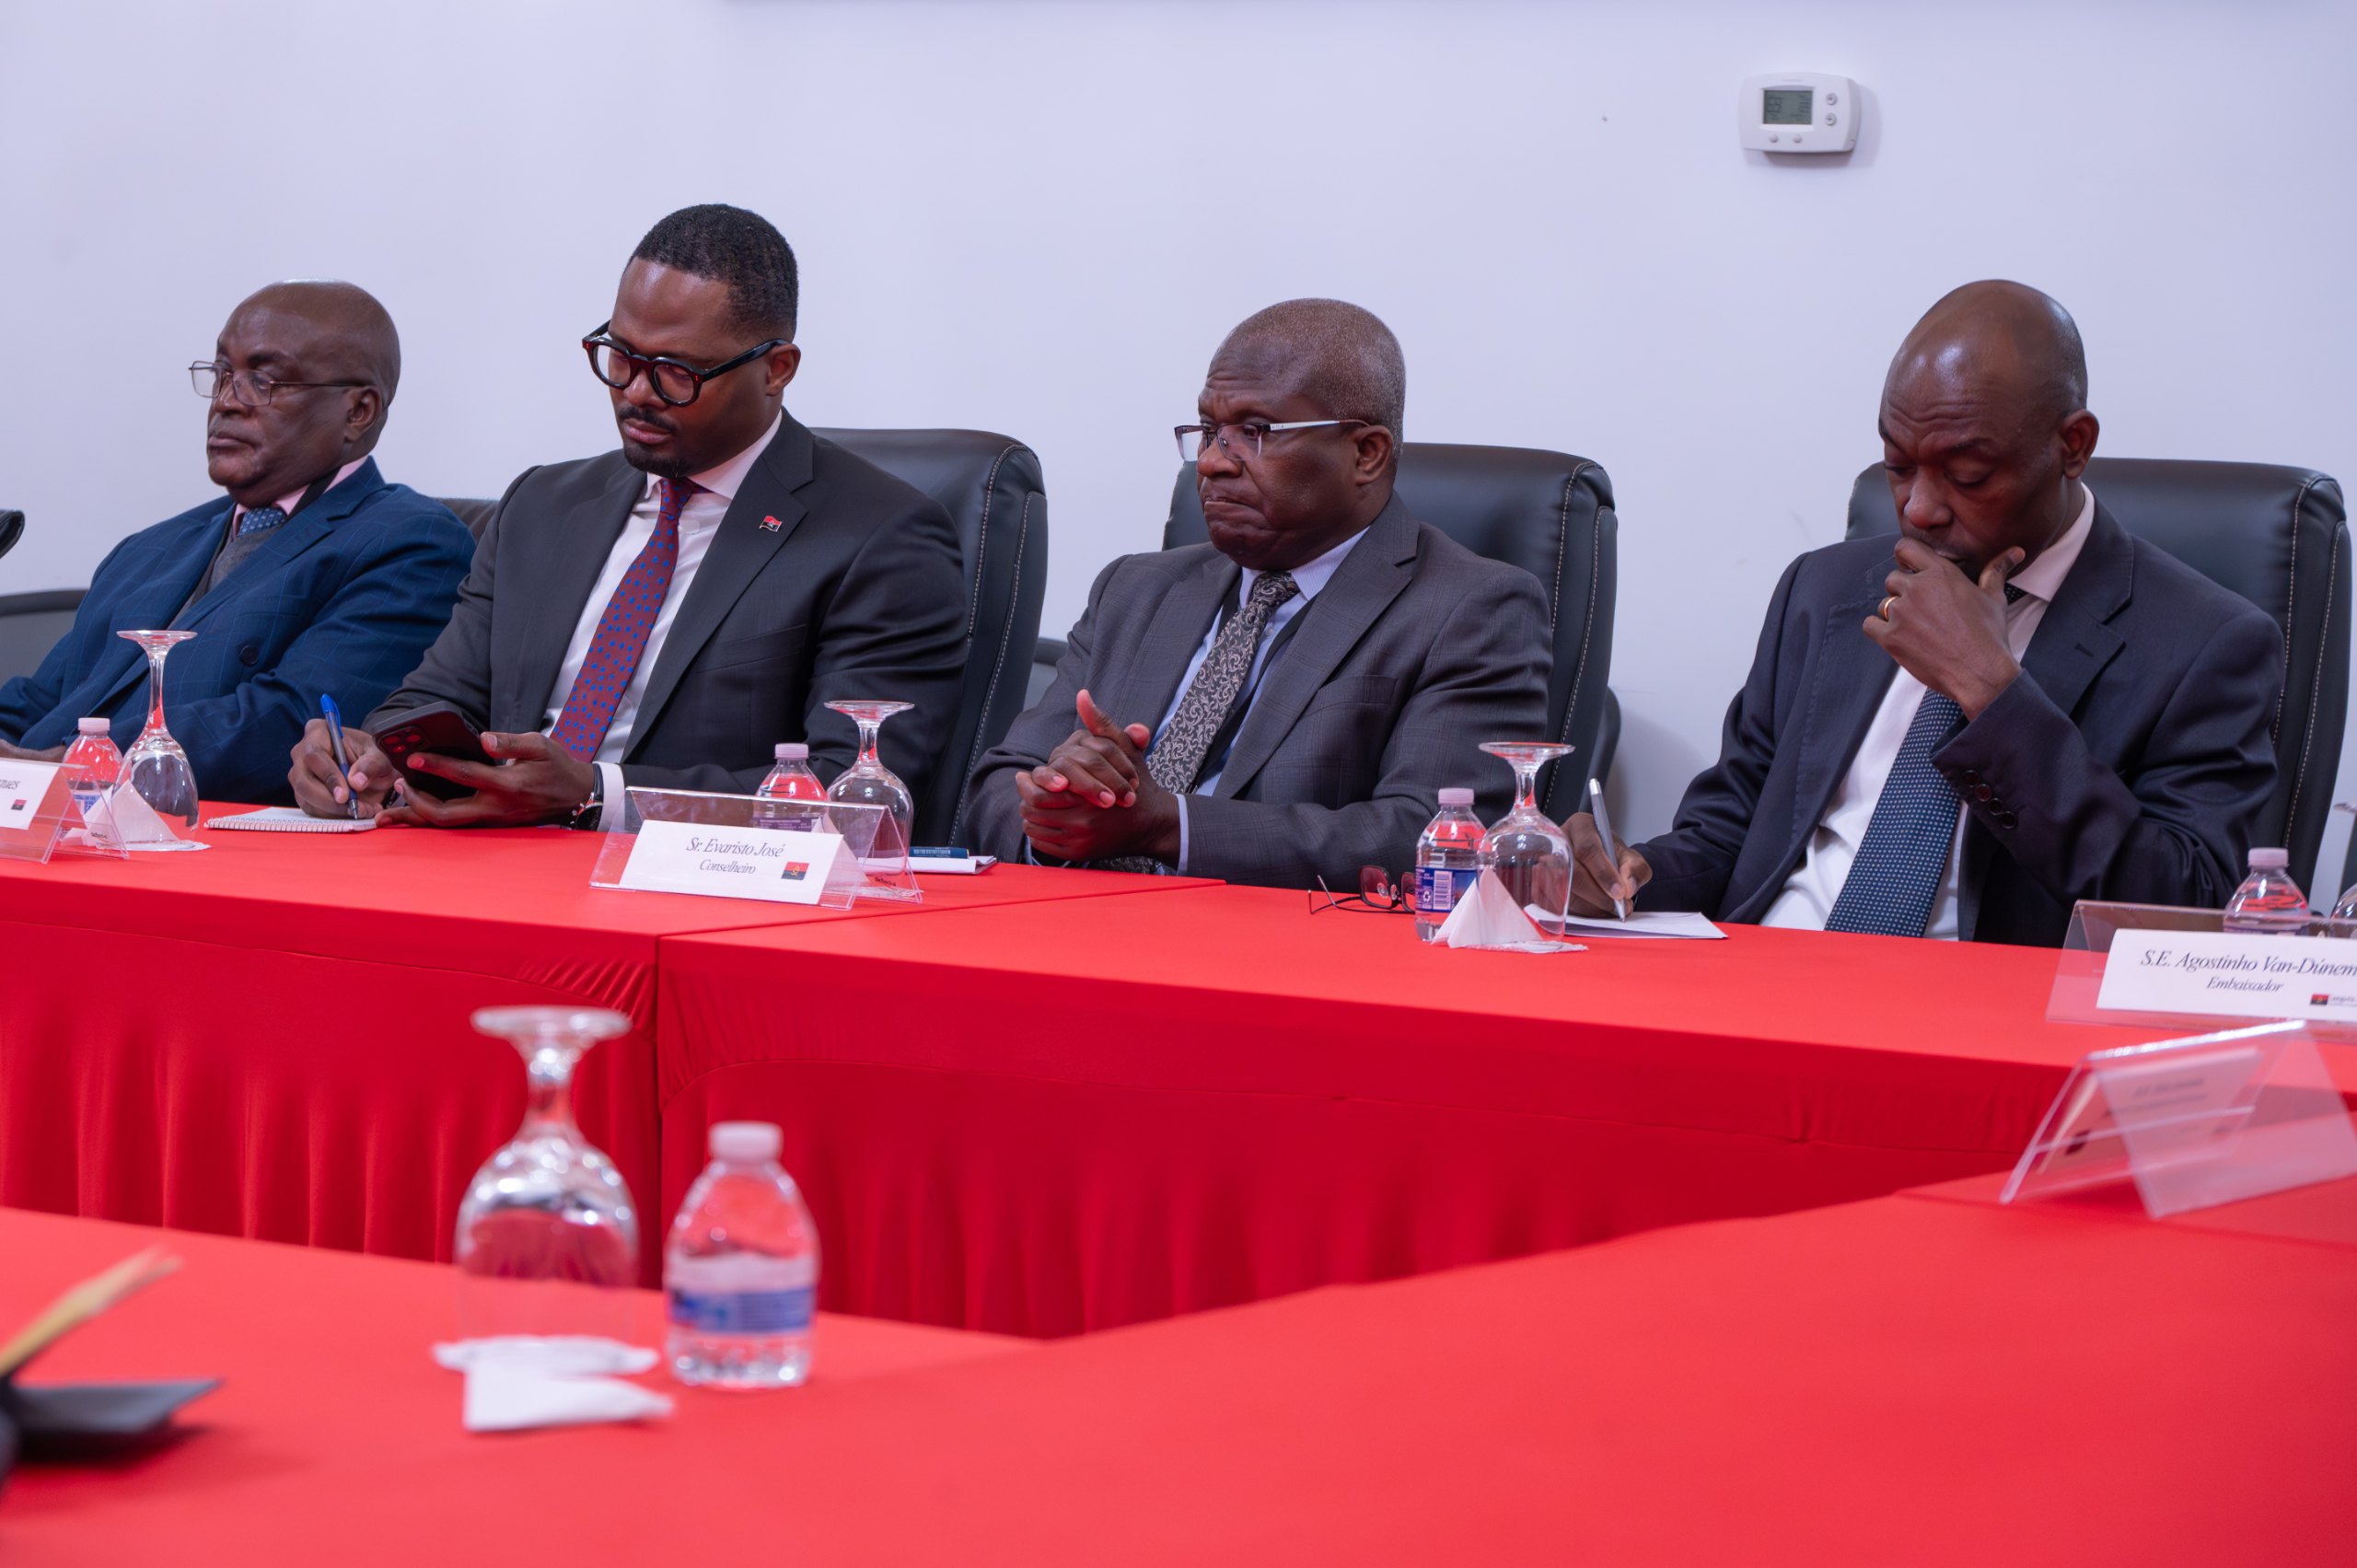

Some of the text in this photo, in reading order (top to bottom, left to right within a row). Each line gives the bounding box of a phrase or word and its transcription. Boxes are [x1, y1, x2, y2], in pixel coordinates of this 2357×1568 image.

[686, 836, 786, 857] Sr. Evaristo José
[699, 858, 757, 875] Conselheiro
[2140, 949, 2357, 977] S.E. Agostinho Van-Dúnem
[2206, 975, 2284, 993] Embaixador
